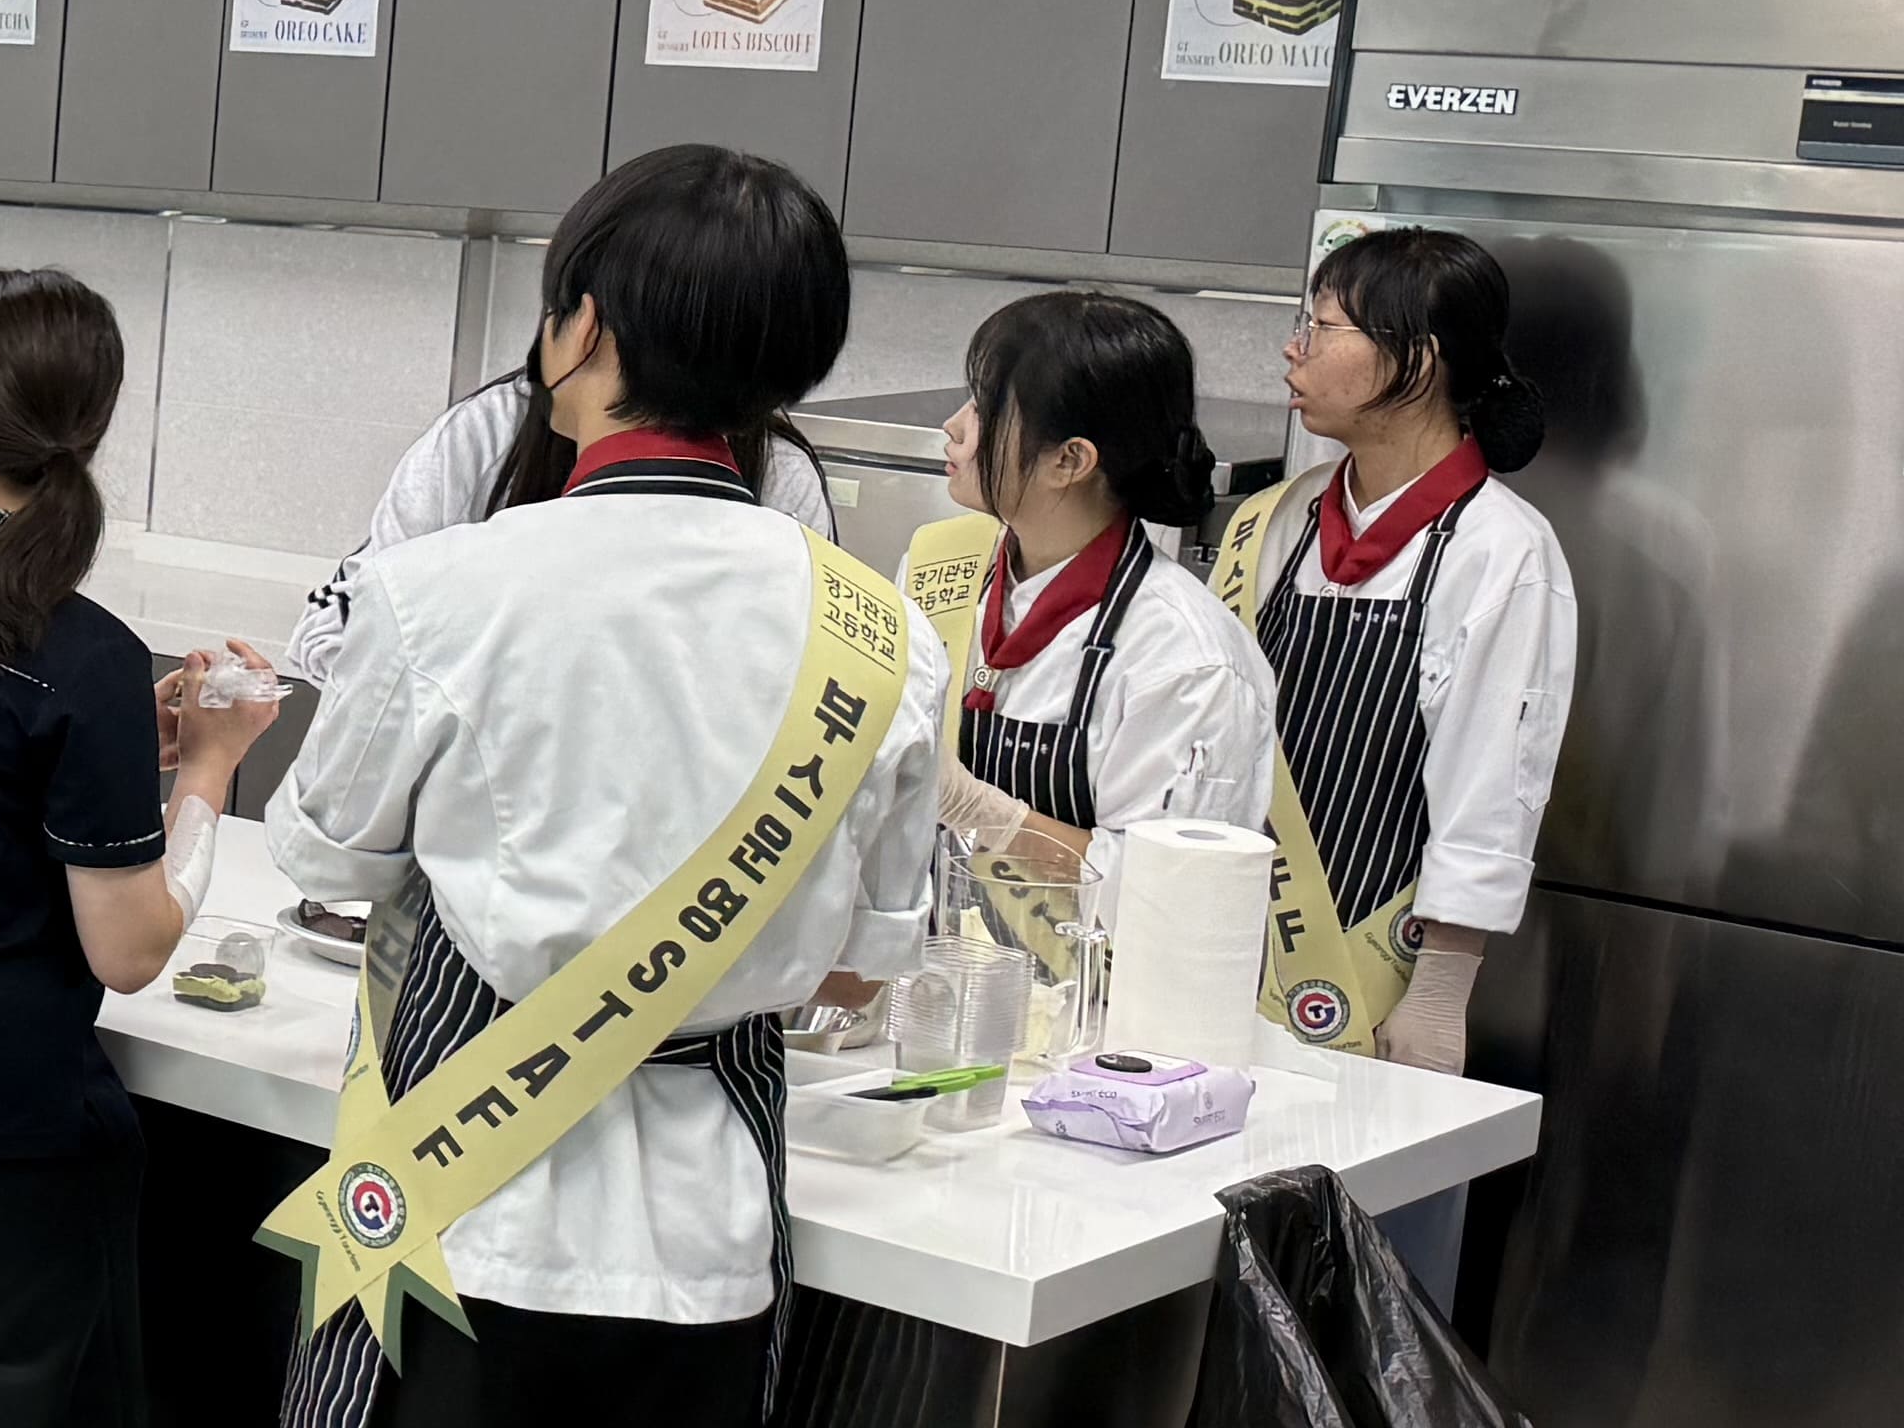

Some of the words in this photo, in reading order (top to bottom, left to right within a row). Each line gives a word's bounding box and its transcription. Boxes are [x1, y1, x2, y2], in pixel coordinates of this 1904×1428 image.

[275, 19, 318, 41] OREO
[323, 22, 367, 44] CAKE
[692, 30, 741, 49] LOTUS
[746, 32, 815, 53] BISCOFF
[1219, 42, 1273, 65] OREO
[1387, 83, 1518, 114] EVERZEN
[912, 560, 979, 591] 경기관광
[823, 571, 898, 635] 경기관광
[823, 600, 896, 661] 고등학교
